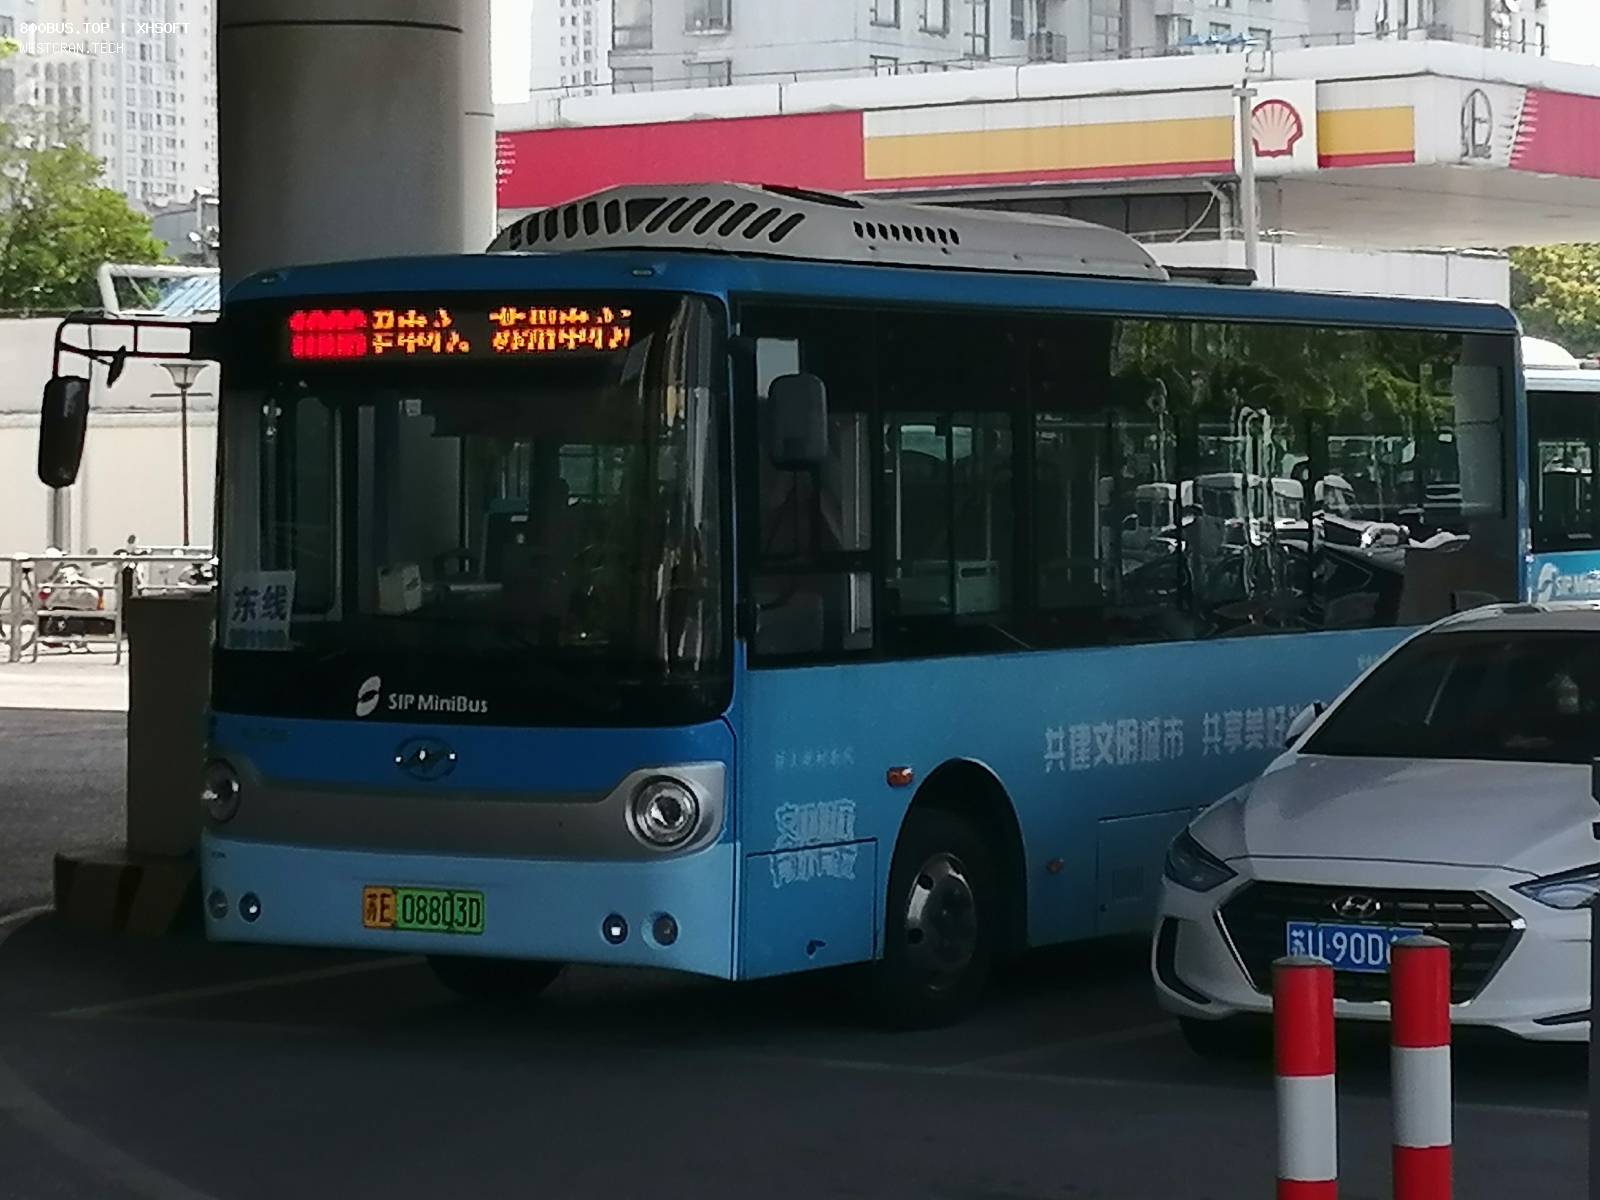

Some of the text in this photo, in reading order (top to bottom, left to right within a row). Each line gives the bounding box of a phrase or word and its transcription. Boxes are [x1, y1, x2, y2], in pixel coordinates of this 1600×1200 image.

[231, 586, 288, 622] 东线
[388, 693, 489, 714] SIP MiniBus
[1044, 717, 1184, 773] 共建文明城市
